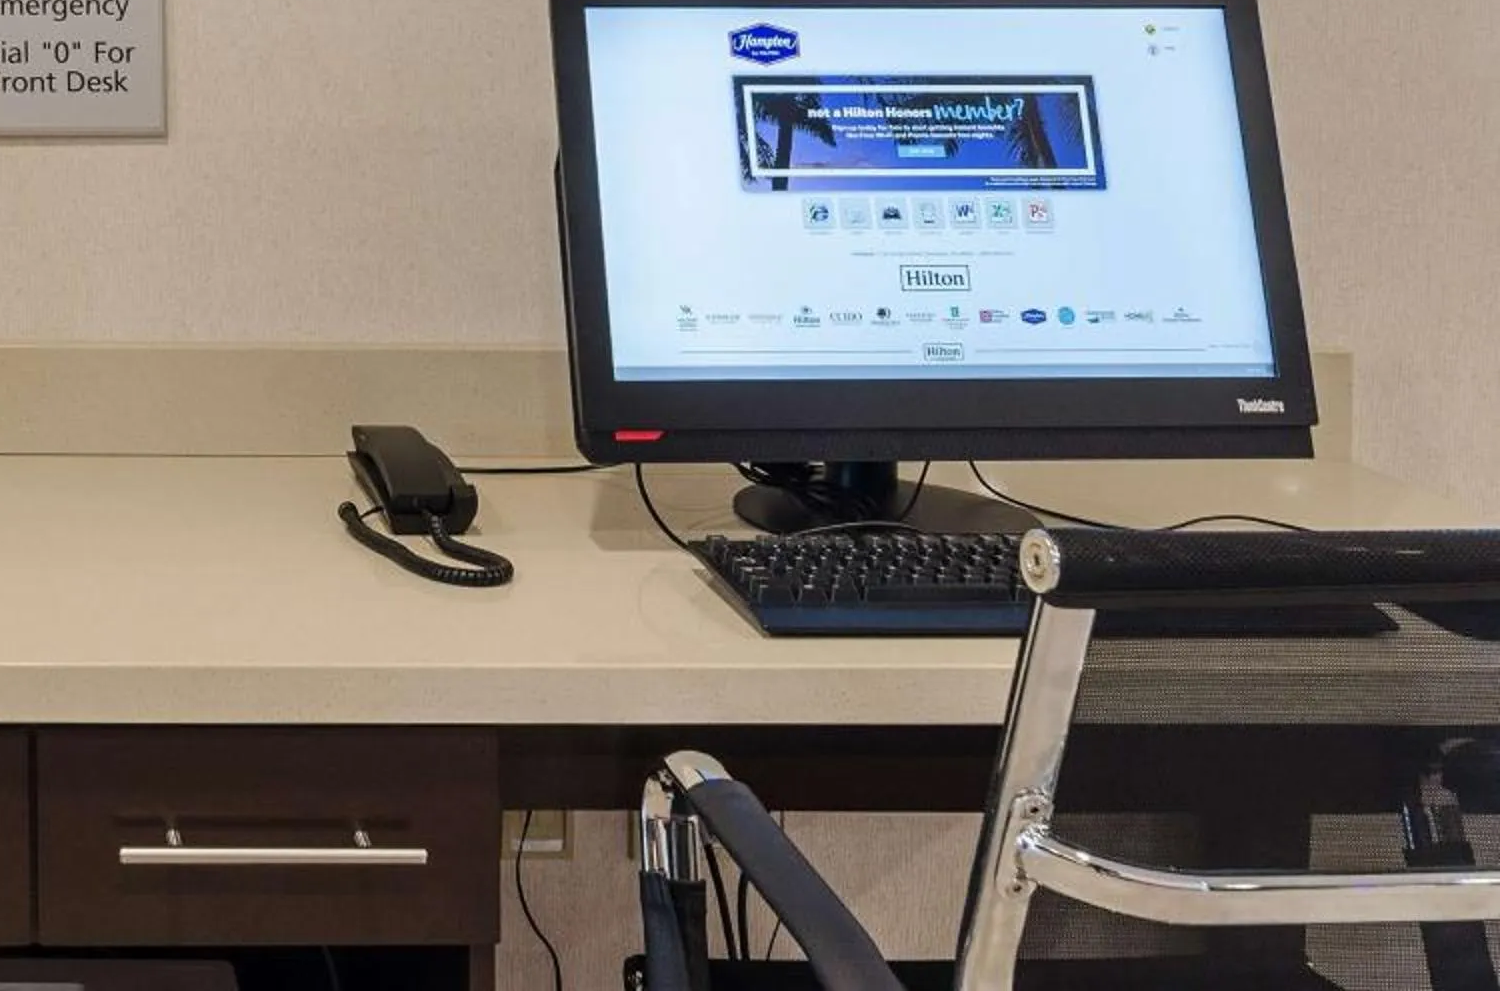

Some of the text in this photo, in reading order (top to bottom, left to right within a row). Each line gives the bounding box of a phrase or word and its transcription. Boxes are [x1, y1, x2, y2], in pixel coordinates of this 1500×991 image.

[43, 41, 81, 64] "0"
[94, 41, 136, 64] For
[66, 69, 129, 93] Desk
[807, 96, 1025, 121] not a Hilton Honors member?
[906, 270, 965, 287] Hilton
